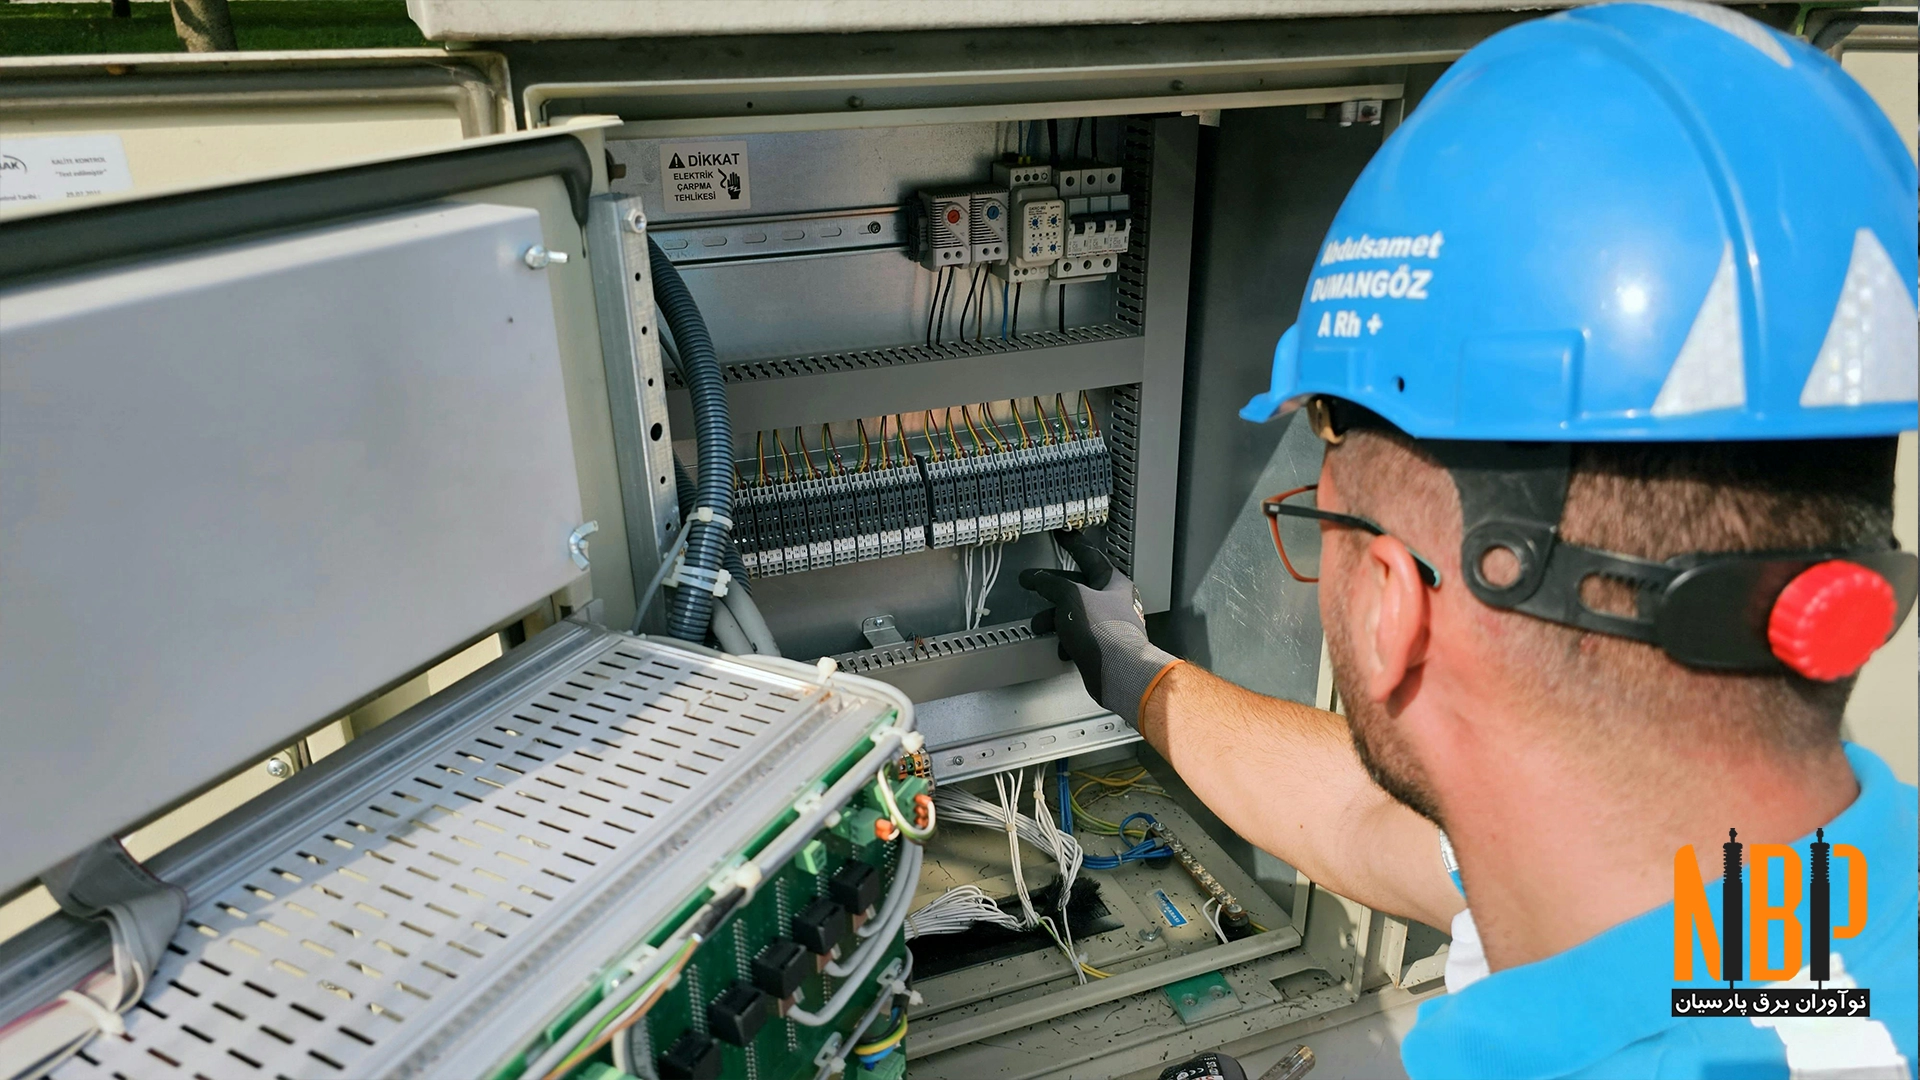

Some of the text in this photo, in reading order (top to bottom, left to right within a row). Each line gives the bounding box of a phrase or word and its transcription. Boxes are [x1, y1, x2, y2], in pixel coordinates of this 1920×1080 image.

[75, 156, 106, 164] KONTROL
[688, 151, 740, 167] DİKKAT
[673, 170, 714, 180] ELEKTRİK
[677, 182, 712, 192] ÇARPMA
[674, 191, 716, 201] TEHLİKESİ
[1320, 230, 1444, 266] Abdulsamet
[1310, 264, 1433, 303] DUMANGÖZ
[1317, 311, 1331, 337] A
[1334, 310, 1361, 338] Rh
